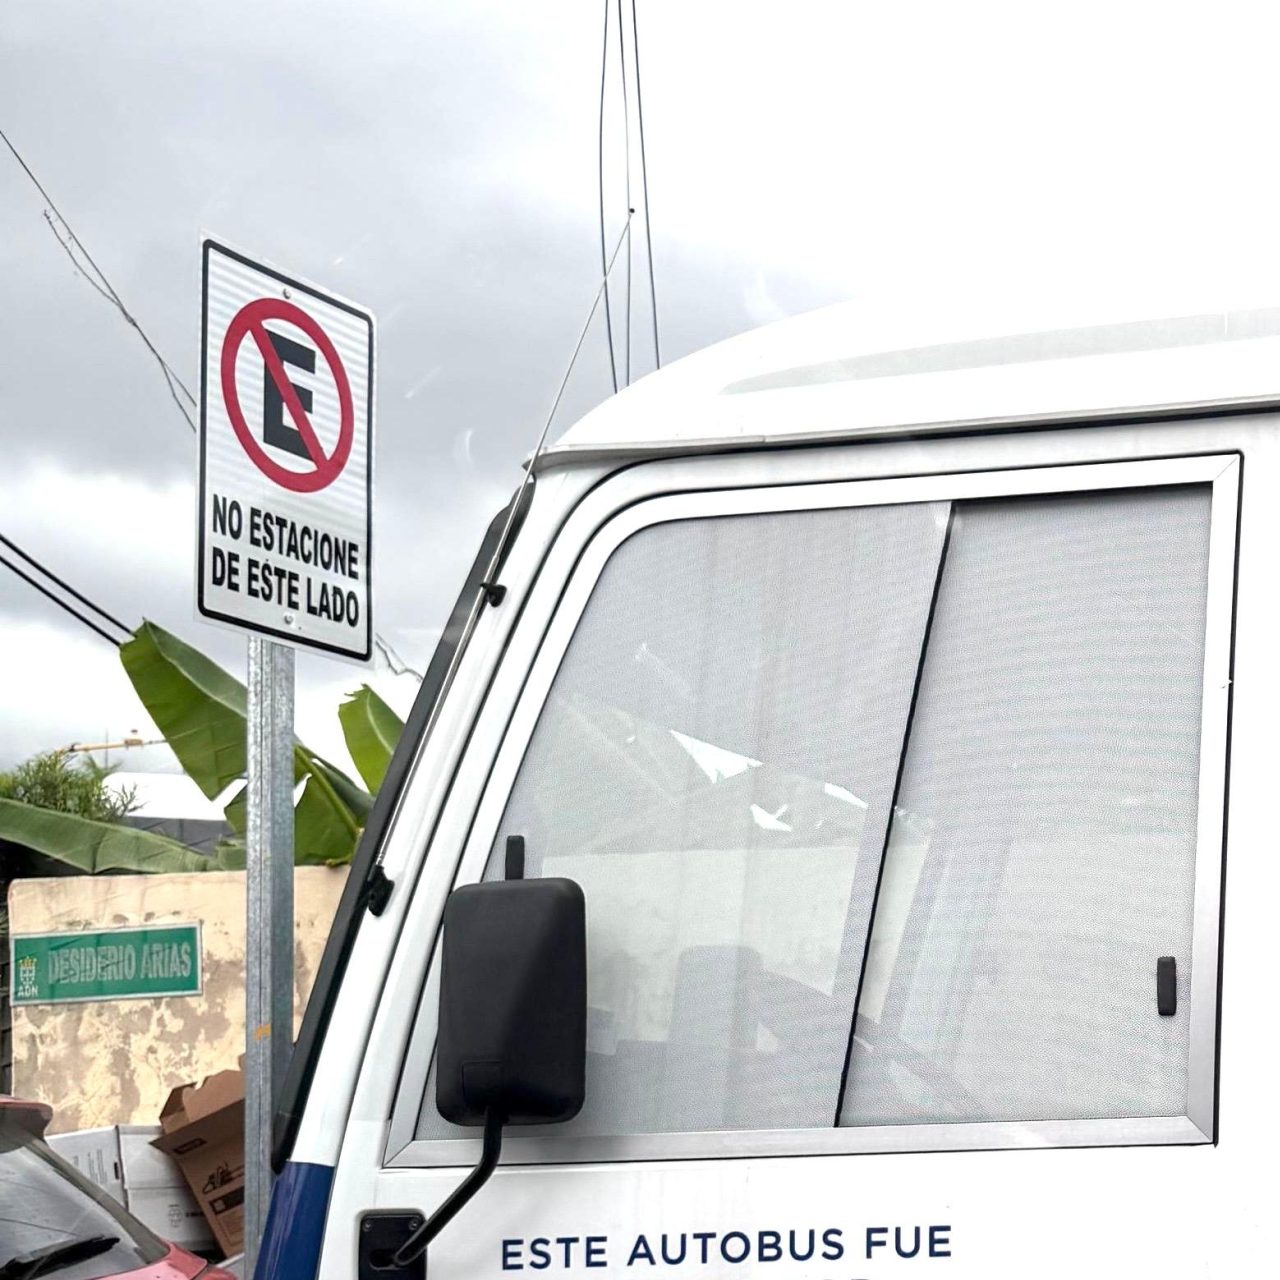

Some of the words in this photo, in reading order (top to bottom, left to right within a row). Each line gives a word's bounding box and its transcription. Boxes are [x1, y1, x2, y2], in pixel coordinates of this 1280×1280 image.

[212, 494, 242, 540] NO
[250, 506, 359, 579] ESTACIONE
[212, 547, 239, 591] DE
[247, 559, 300, 610] ESTE
[306, 581, 359, 628] LADO
[48, 944, 136, 984] DESIDERIO
[140, 942, 191, 978] ARIAS
[17, 986, 38, 997] ADN
[501, 1236, 608, 1270] ESTE
[627, 1228, 845, 1266] AUTOBUS
[865, 1225, 952, 1259] FUE
